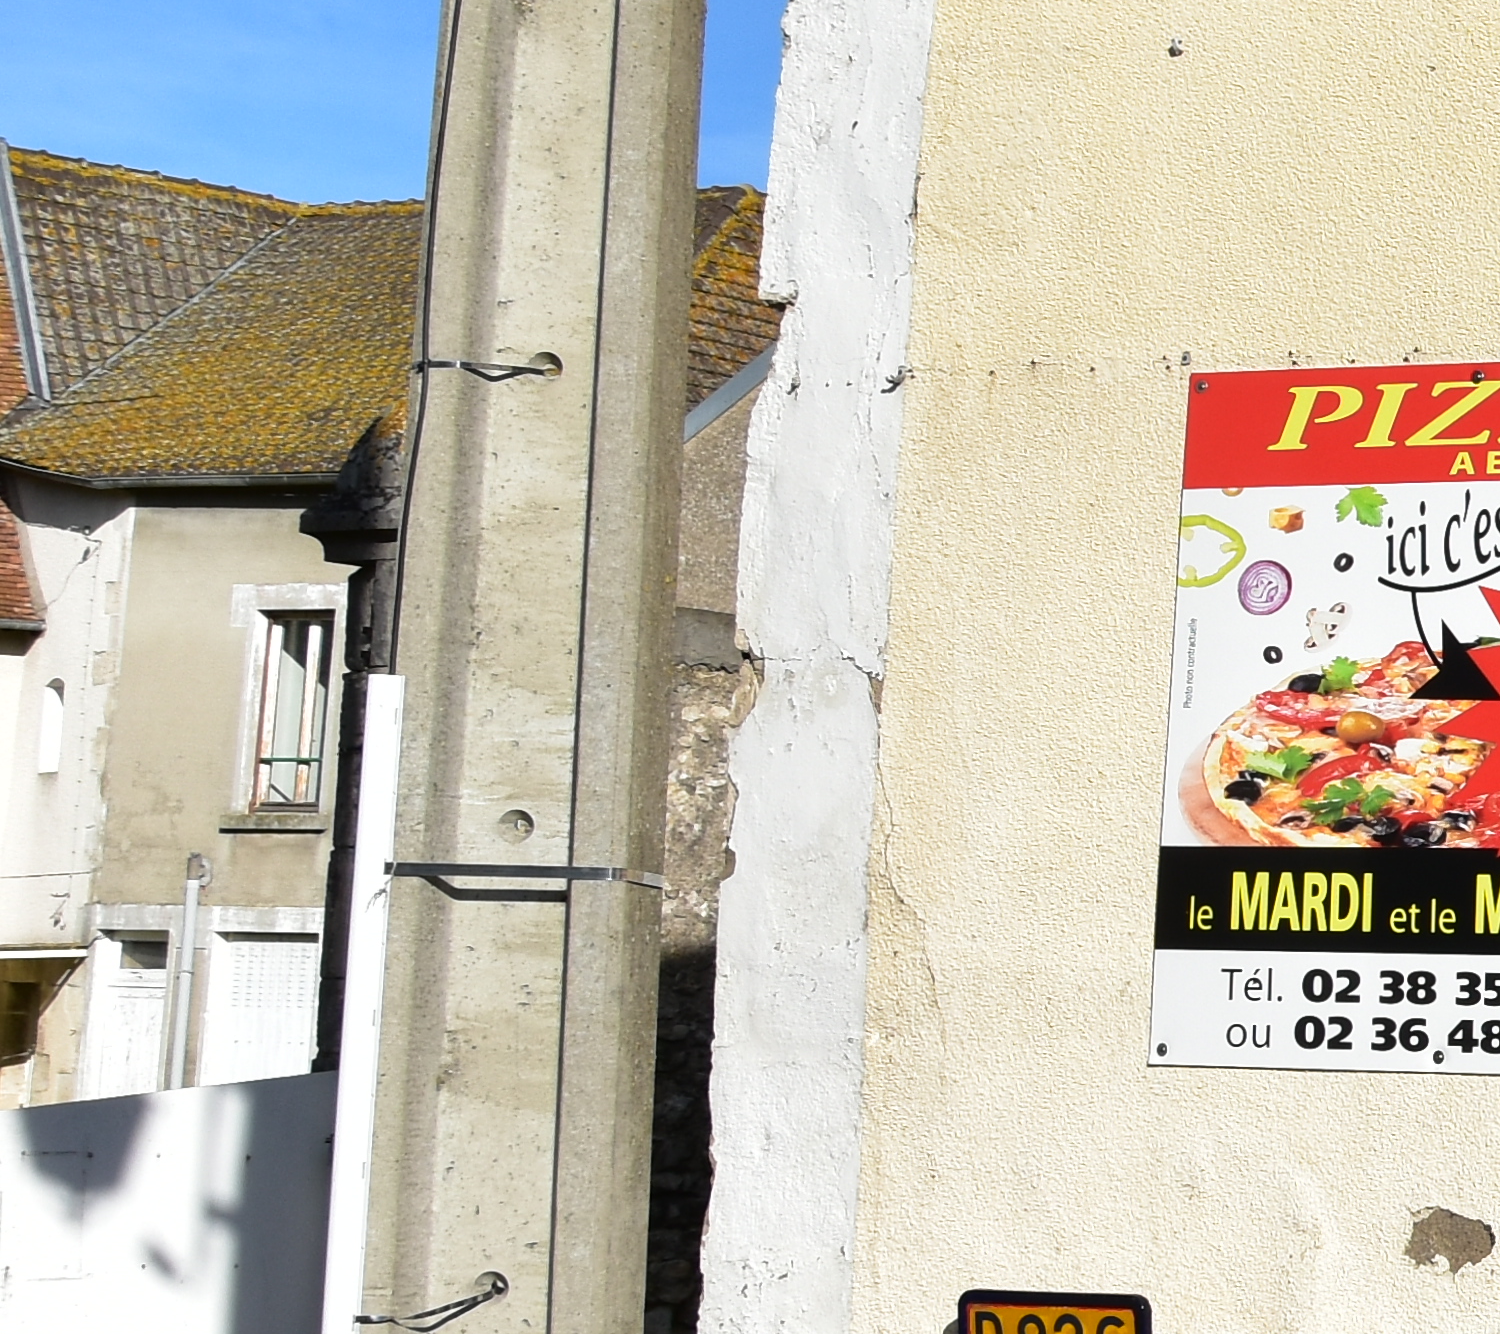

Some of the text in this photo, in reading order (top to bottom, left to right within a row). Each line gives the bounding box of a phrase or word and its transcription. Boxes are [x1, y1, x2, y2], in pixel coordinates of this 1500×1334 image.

[1449, 450, 1476, 476] A
[1385, 509, 1428, 576] ici
[1185, 669, 1195, 685] non
[1182, 685, 1194, 709] Photo
[1188, 896, 1213, 930] le
[1229, 871, 1374, 933] MARDI
[1388, 901, 1420, 934] et
[1429, 898, 1457, 935] le
[1221, 968, 1284, 1003] Tél.
[1301, 968, 1362, 1004] 02
[1378, 970, 1437, 1005] 38
[1225, 1021, 1272, 1049] ou
[1293, 1015, 1354, 1050] 02
[1370, 1017, 1430, 1052] 36
